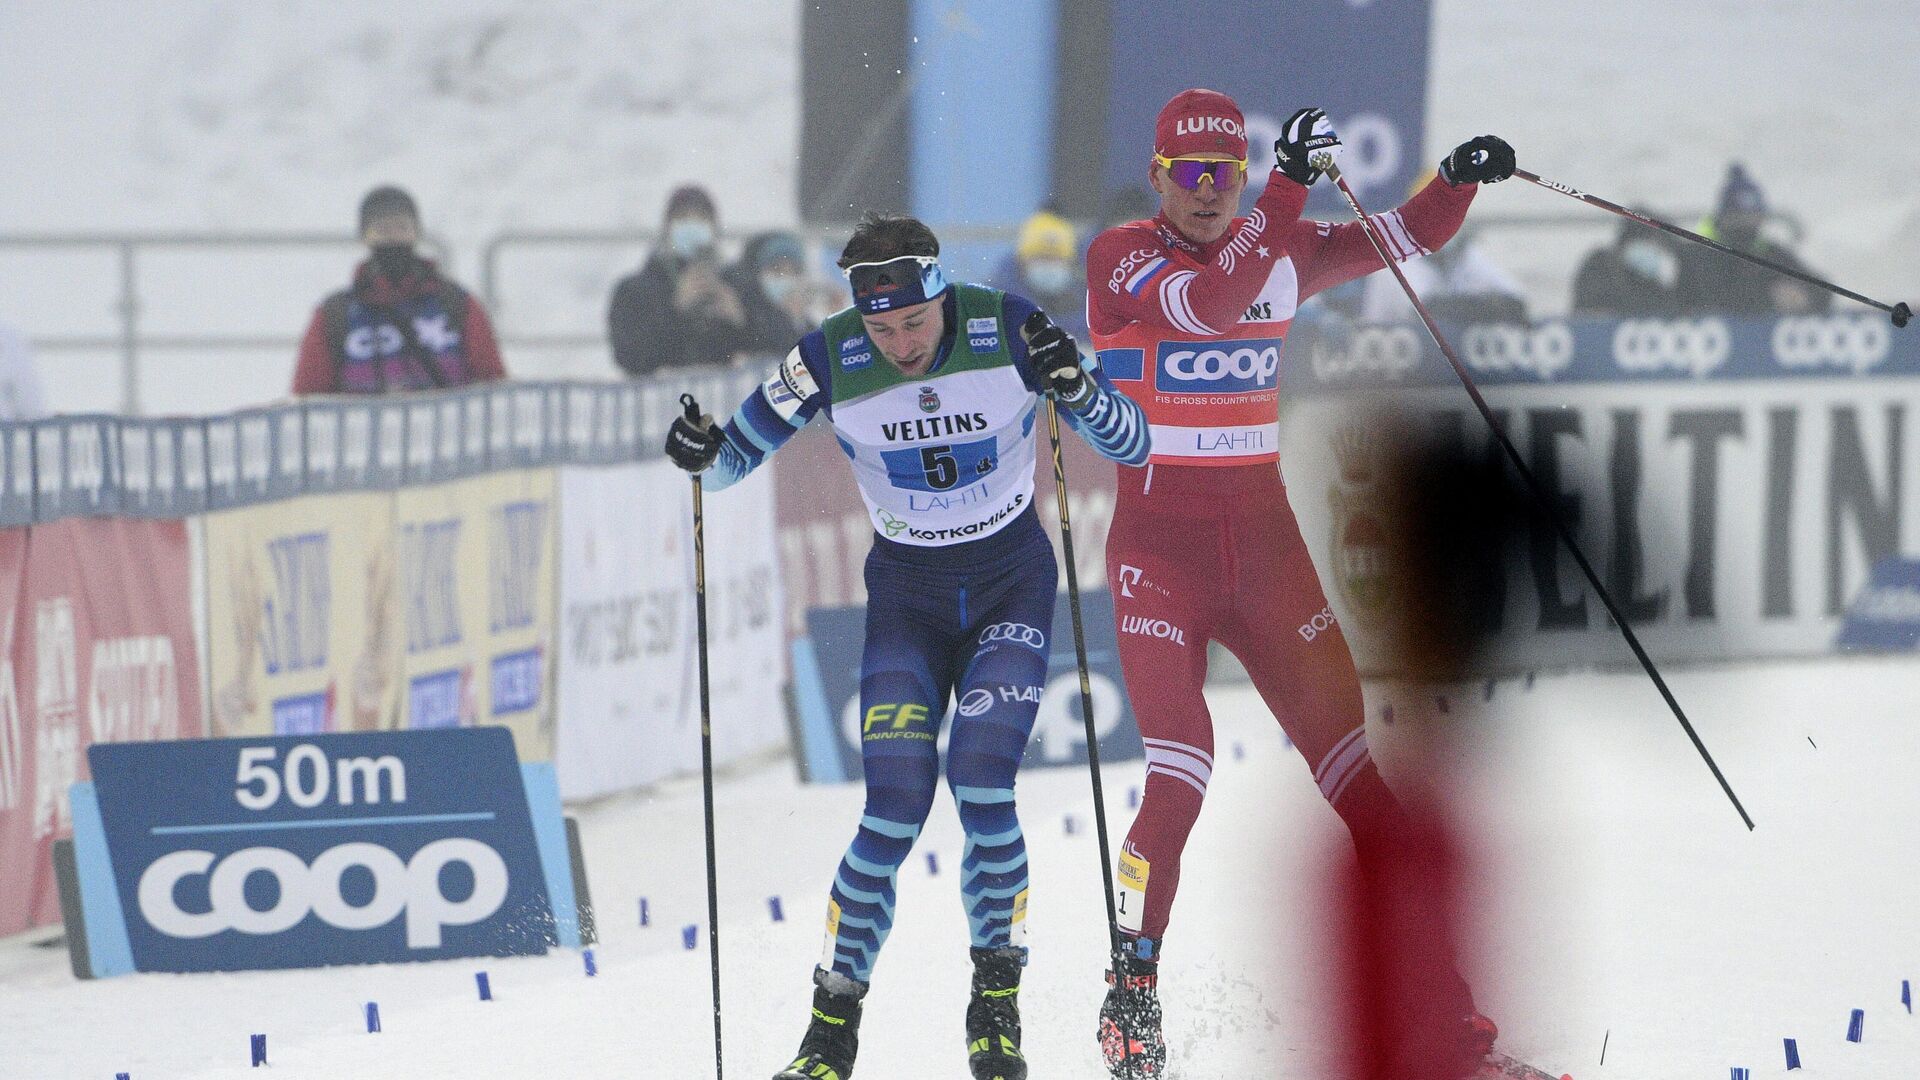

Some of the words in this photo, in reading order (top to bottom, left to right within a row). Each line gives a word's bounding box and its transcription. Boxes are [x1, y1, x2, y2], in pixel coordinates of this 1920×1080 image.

[970, 336, 998, 347] coop
[1612, 317, 1731, 378] coop
[1770, 314, 1891, 376] coop
[842, 351, 871, 366] coop
[1165, 346, 1279, 386] coop
[1155, 395, 1170, 404] FIS
[1173, 396, 1208, 405] CROSS
[1210, 394, 1248, 405] COUNTRY
[1250, 393, 1271, 403] WORLD
[881, 412, 988, 441] VELTINS
[1196, 430, 1264, 451] LAHTI
[920, 445, 958, 490] 5
[910, 483, 989, 512] LAHTI
[1430, 406, 1906, 632] ELTIN
[1121, 615, 1185, 647] LUKOIL
[1298, 604, 1337, 641] BOS
[864, 704, 929, 732] FF
[236, 744, 407, 810] 50m
[138, 838, 509, 949] coop
[1118, 891, 1127, 915] 1
